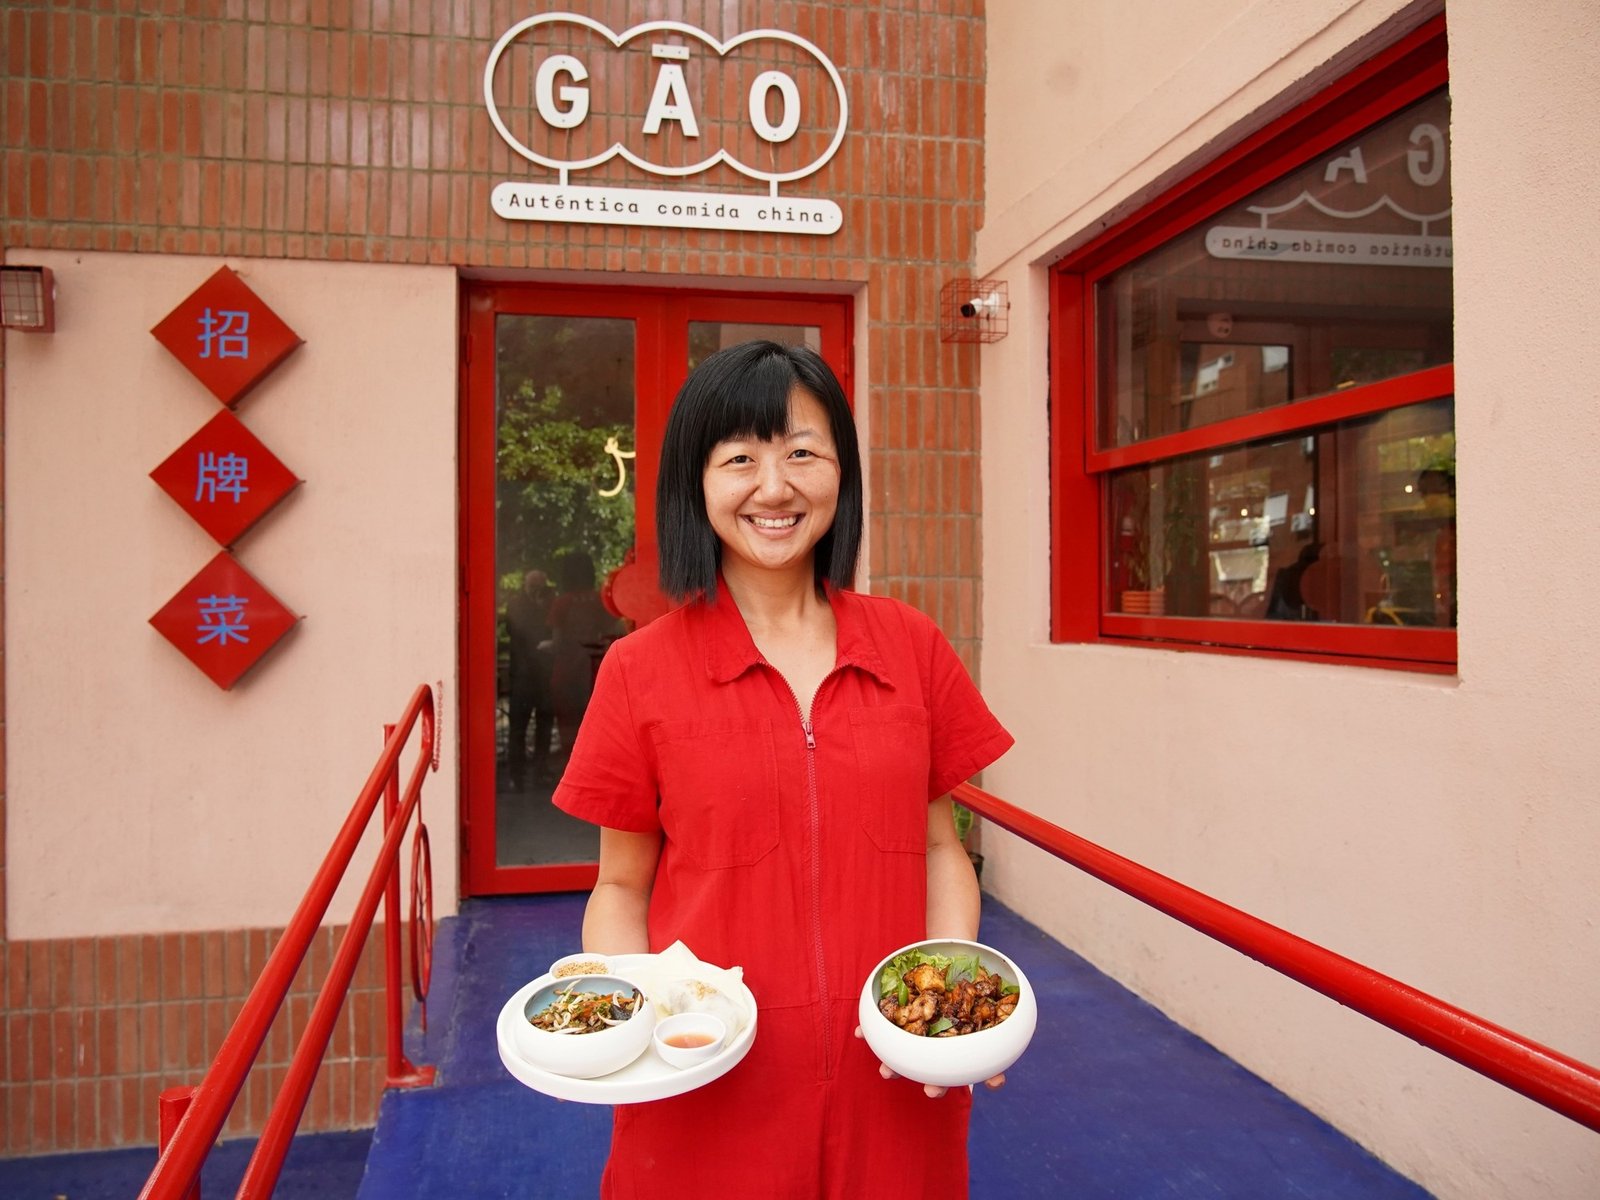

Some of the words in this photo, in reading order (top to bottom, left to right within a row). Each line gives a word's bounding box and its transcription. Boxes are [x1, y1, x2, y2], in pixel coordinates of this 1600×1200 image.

[508, 192, 640, 214] Auténtica
[657, 202, 740, 219] comida
[757, 207, 824, 223] china
[195, 307, 250, 646] 招牌菜
